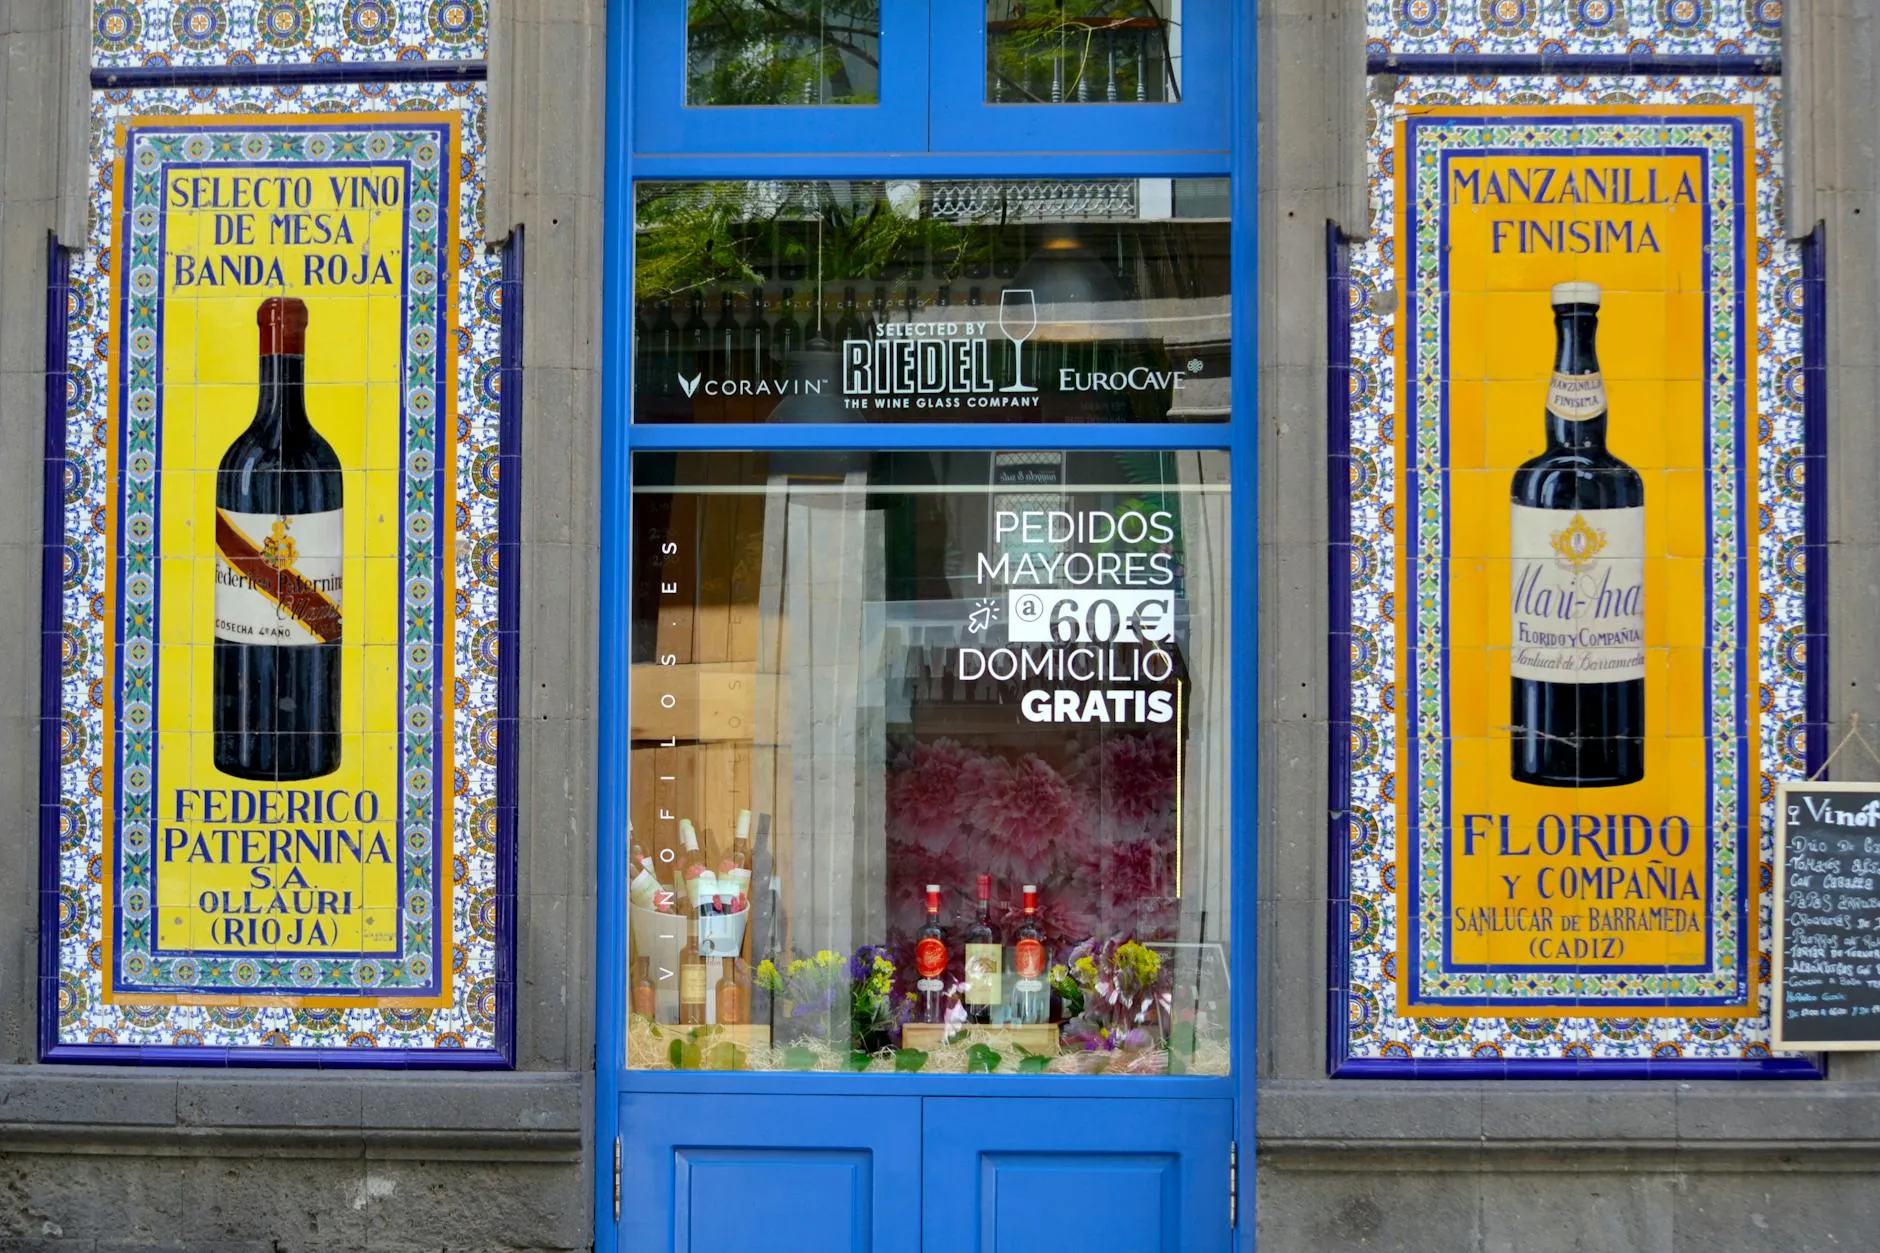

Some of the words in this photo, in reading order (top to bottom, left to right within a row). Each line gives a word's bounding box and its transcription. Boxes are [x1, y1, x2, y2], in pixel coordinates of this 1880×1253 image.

[171, 177, 312, 209] SELECTO
[329, 175, 400, 208] VINO
[1453, 168, 1697, 204] MANZANILLA
[214, 214, 255, 245] DE
[270, 213, 354, 245] MESA
[1491, 220, 1660, 254] FINISIMA
[876, 323, 958, 337] SELECTED
[965, 322, 987, 336] BY
[843, 338, 994, 394] RIEDEL
[844, 398, 868, 409] THE
[874, 398, 910, 409] WINE
[916, 397, 960, 408] GLASS
[966, 396, 1040, 408] COMPANY
[996, 511, 1174, 544] PEDIDOS
[977, 552, 1174, 585] MAYORES
[215, 618, 254, 635] COSECHA
[1049, 599, 1172, 647] 60€
[959, 648, 1173, 681] DOMICILIO
[1021, 689, 1174, 723] GRATIS
[175, 789, 379, 824] FEDERICO
[164, 828, 393, 864] PATERNINA
[1462, 814, 1690, 862] FLORIDO
[250, 865, 319, 889] S.A.
[1501, 875, 1521, 900] Y
[1537, 860, 1700, 900] COMPAÑIA
[199, 891, 352, 915] OLLAURI
[211, 917, 338, 947] (RIOJA)
[1455, 907, 1554, 934] SANLUCAR
[1561, 915, 1580, 931] DE
[1588, 907, 1701, 934] BARRAMEDA
[1528, 937, 1626, 960] (CADIZ)
